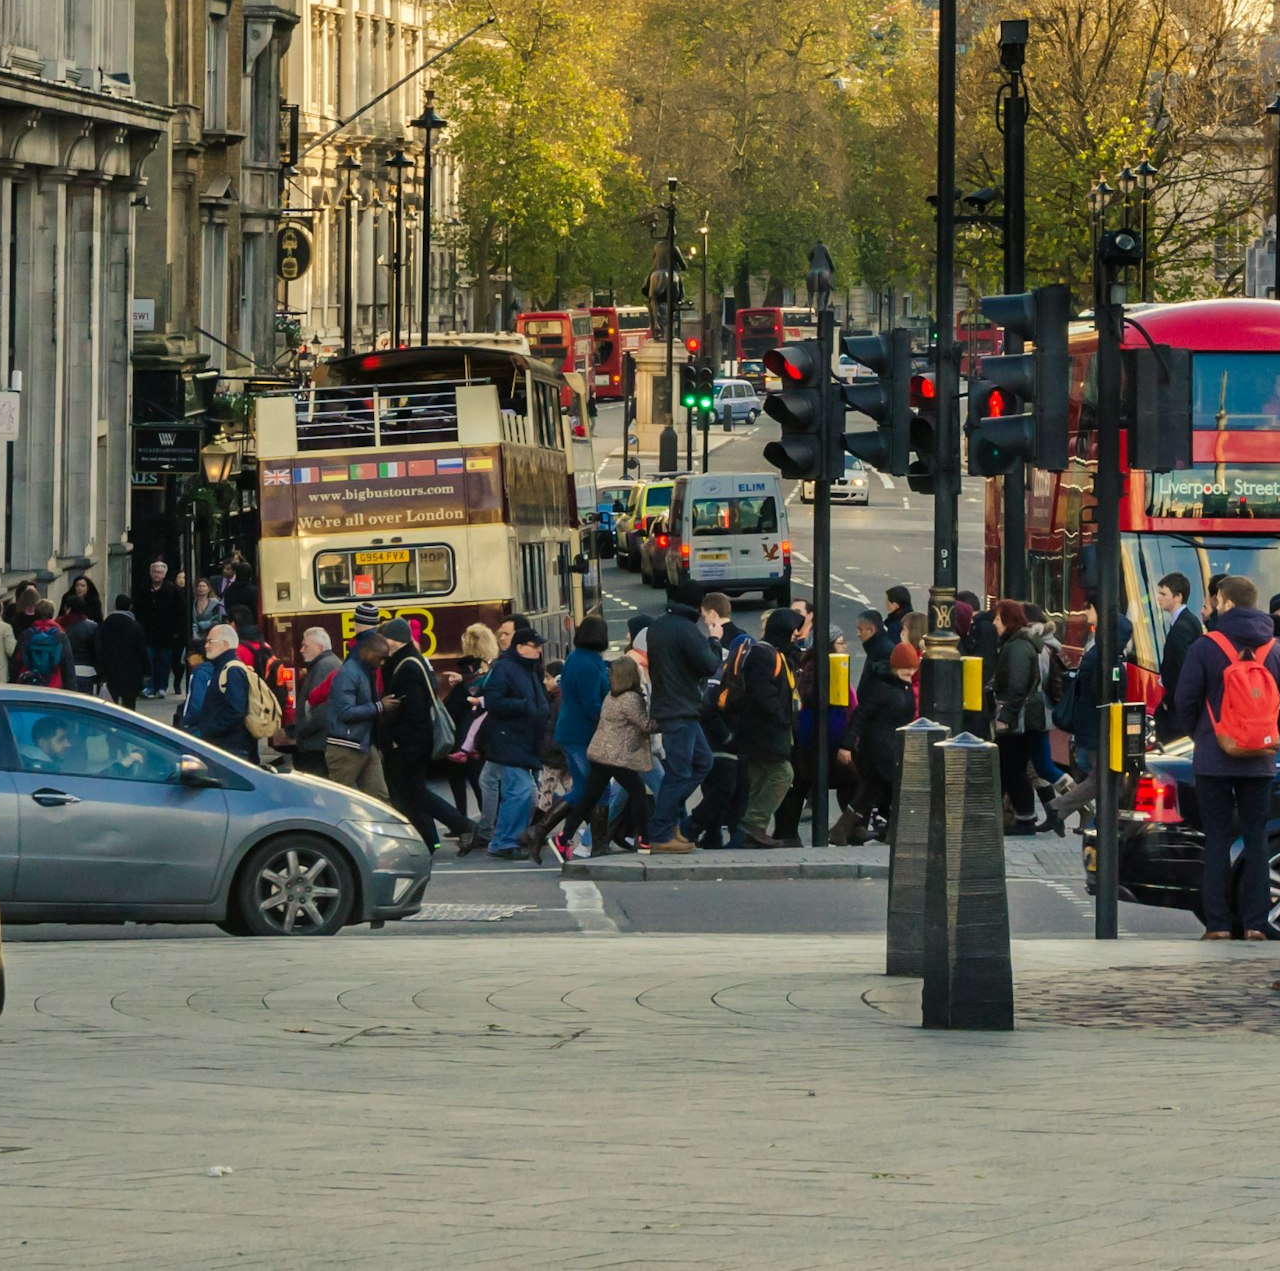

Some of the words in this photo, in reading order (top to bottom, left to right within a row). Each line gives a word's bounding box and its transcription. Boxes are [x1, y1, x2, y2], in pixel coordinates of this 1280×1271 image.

[309, 484, 455, 503] www.bigbustours.com
[738, 482, 765, 492] ELIM
[1160, 478, 1228, 499] Liverpool
[1234, 478, 1280, 496] Street
[298, 515, 342, 529] We're
[345, 513, 365, 527] all
[368, 512, 403, 525] over
[406, 507, 464, 523] London
[360, 552, 384, 563] G954
[386, 551, 405, 562] FVX
